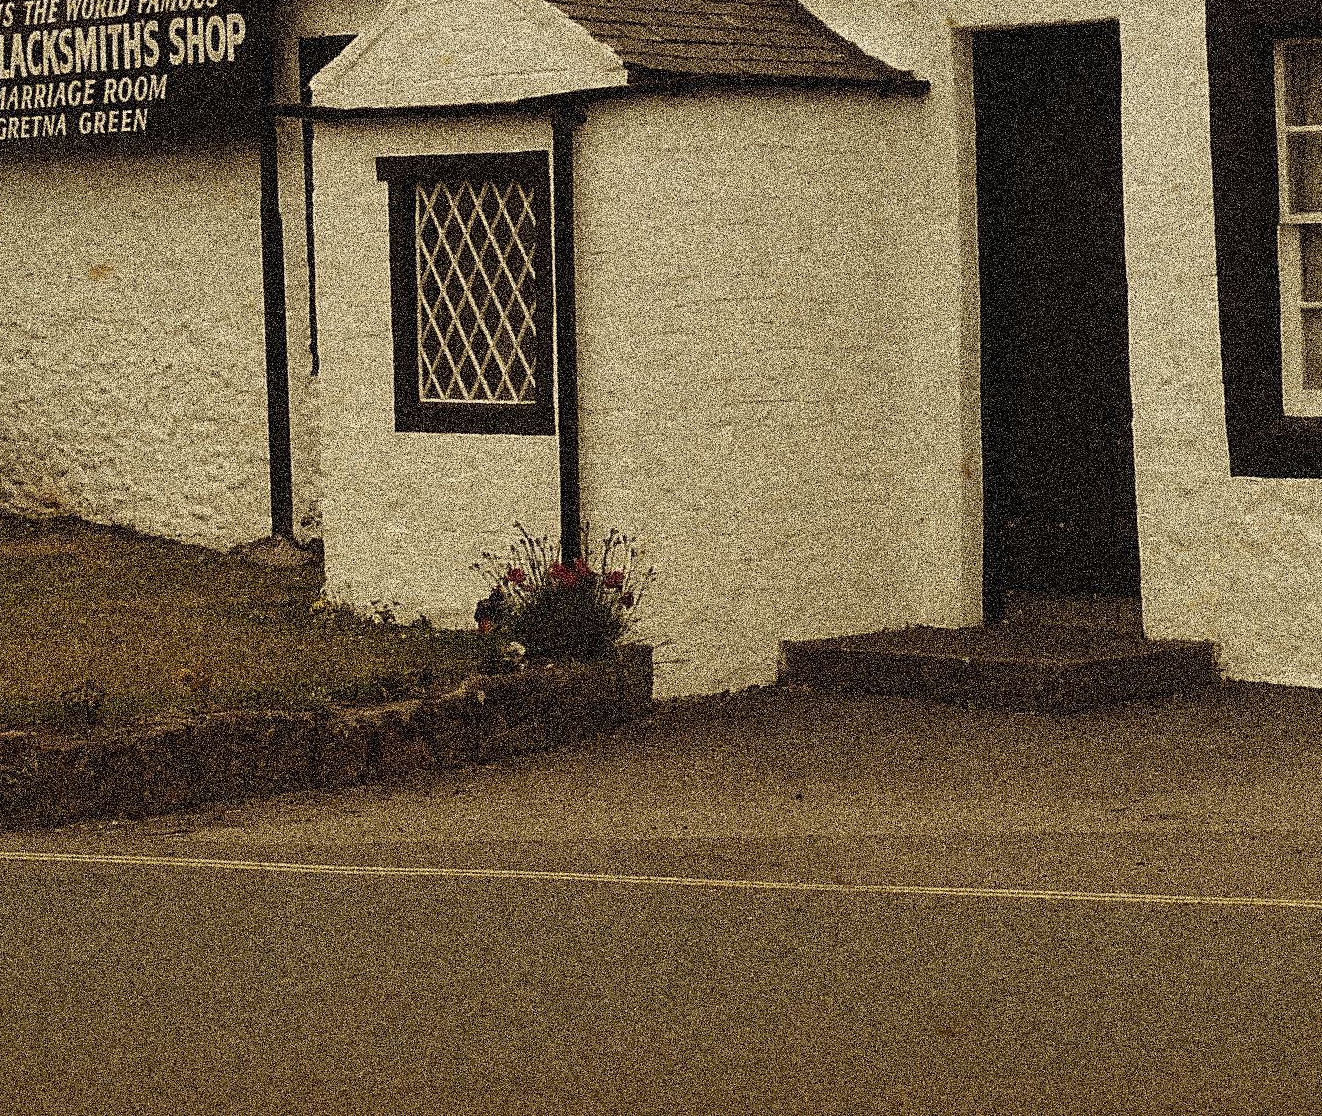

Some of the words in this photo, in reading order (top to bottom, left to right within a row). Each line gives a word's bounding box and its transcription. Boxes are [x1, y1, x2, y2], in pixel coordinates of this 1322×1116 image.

[168, 13, 246, 66] SHOP
[103, 74, 168, 104] ROOM
[79, 109, 148, 135] GREEN
